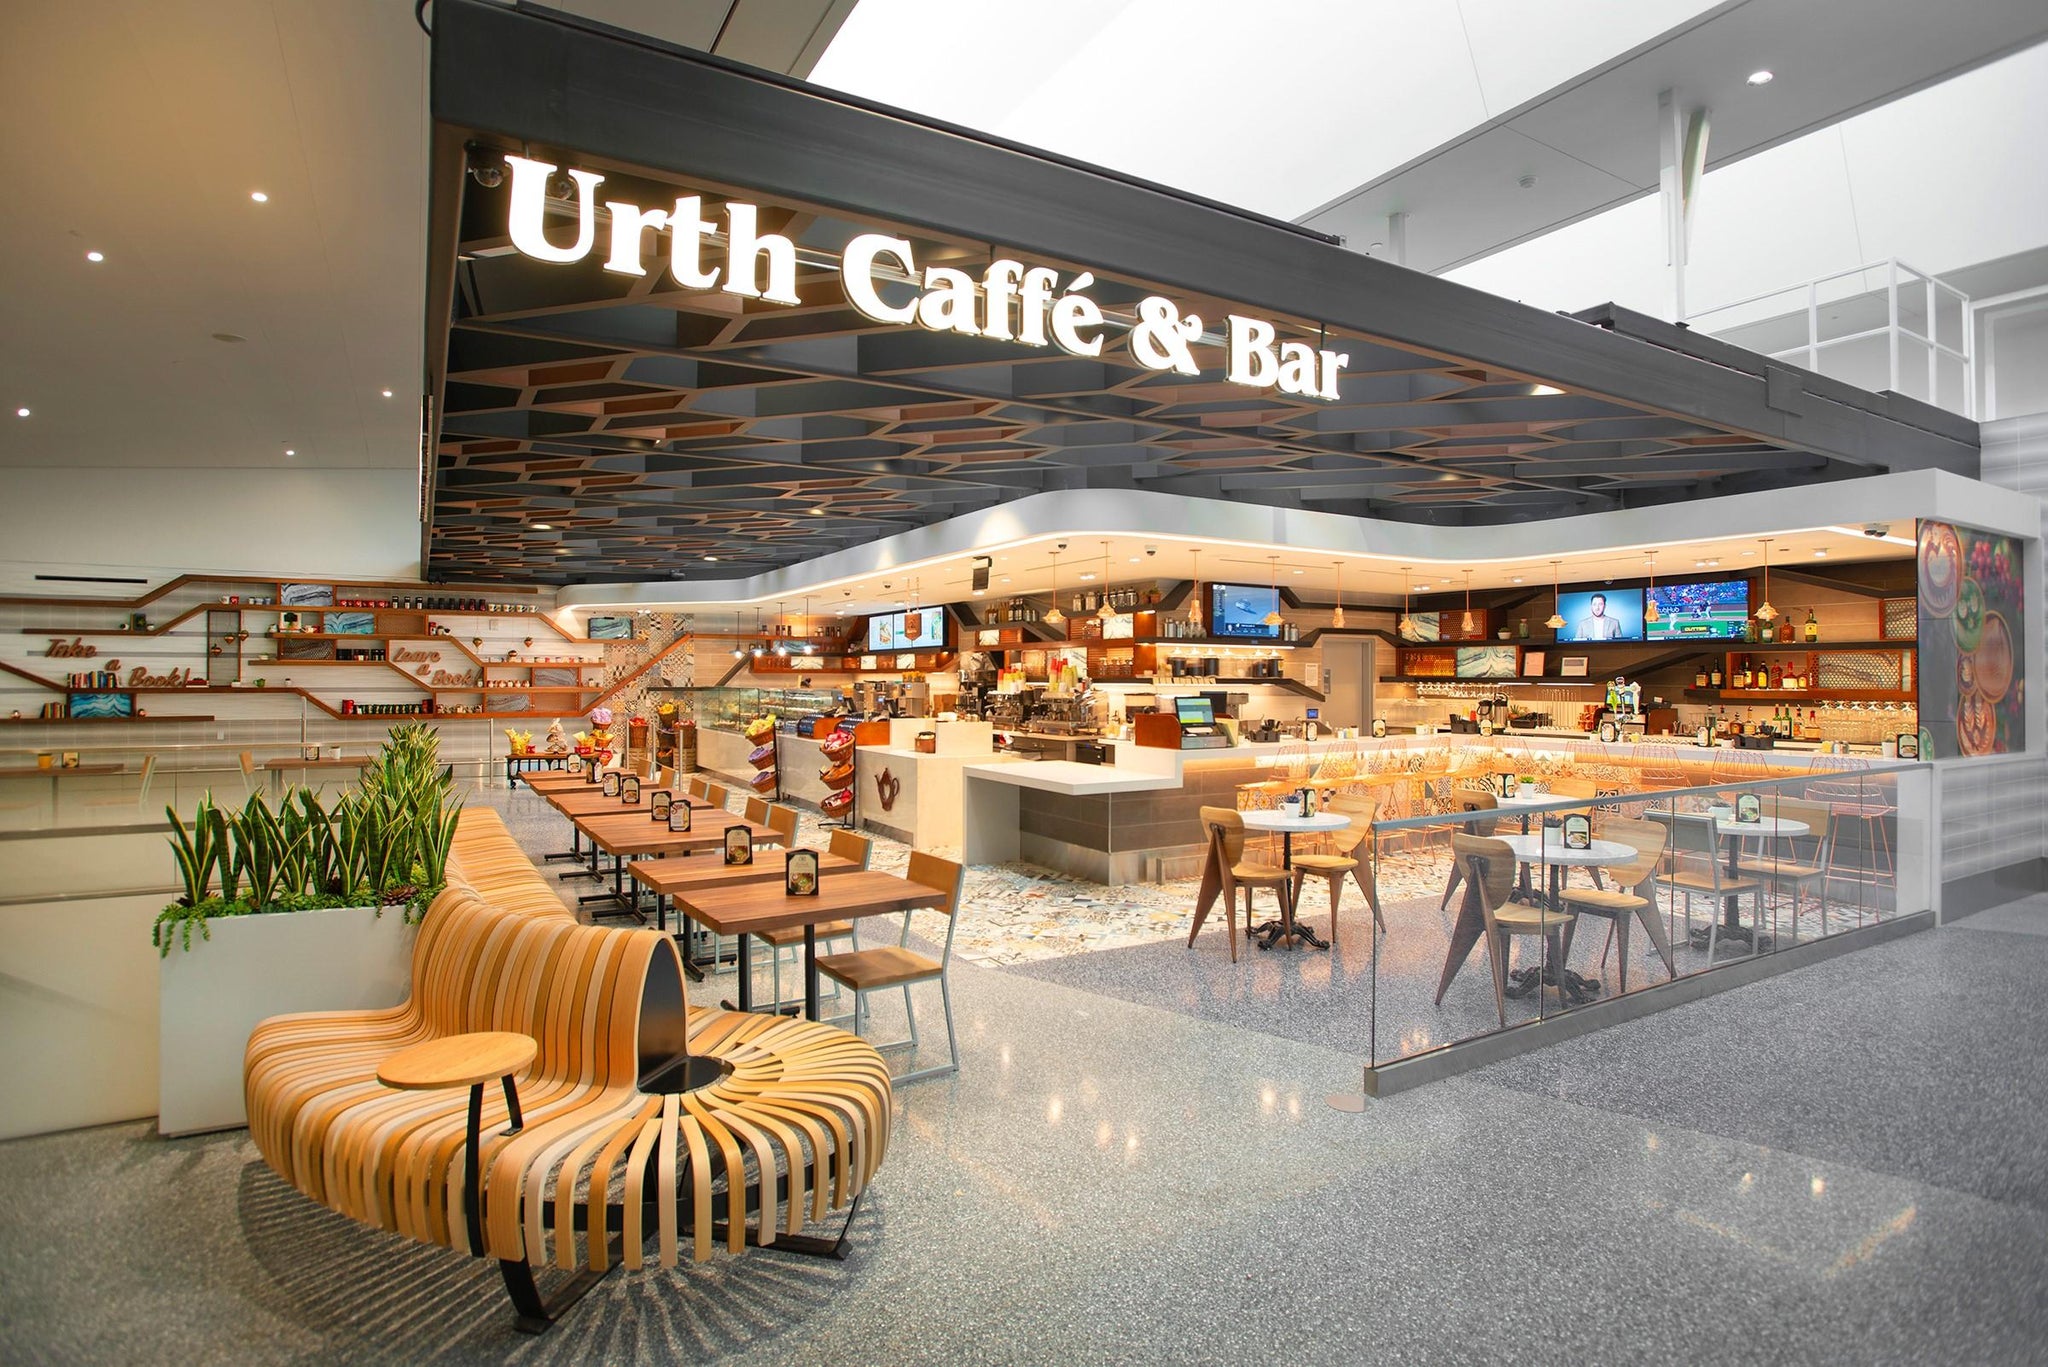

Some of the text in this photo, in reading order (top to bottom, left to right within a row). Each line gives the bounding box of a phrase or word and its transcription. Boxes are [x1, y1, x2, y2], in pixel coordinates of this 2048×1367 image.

[503, 155, 1349, 400] Urth Caffé & Bar
[45, 637, 97, 658] Take
[393, 647, 441, 662] Leave
[104, 659, 121, 671] a
[416, 663, 431, 675] a
[128, 666, 191, 687] Book!
